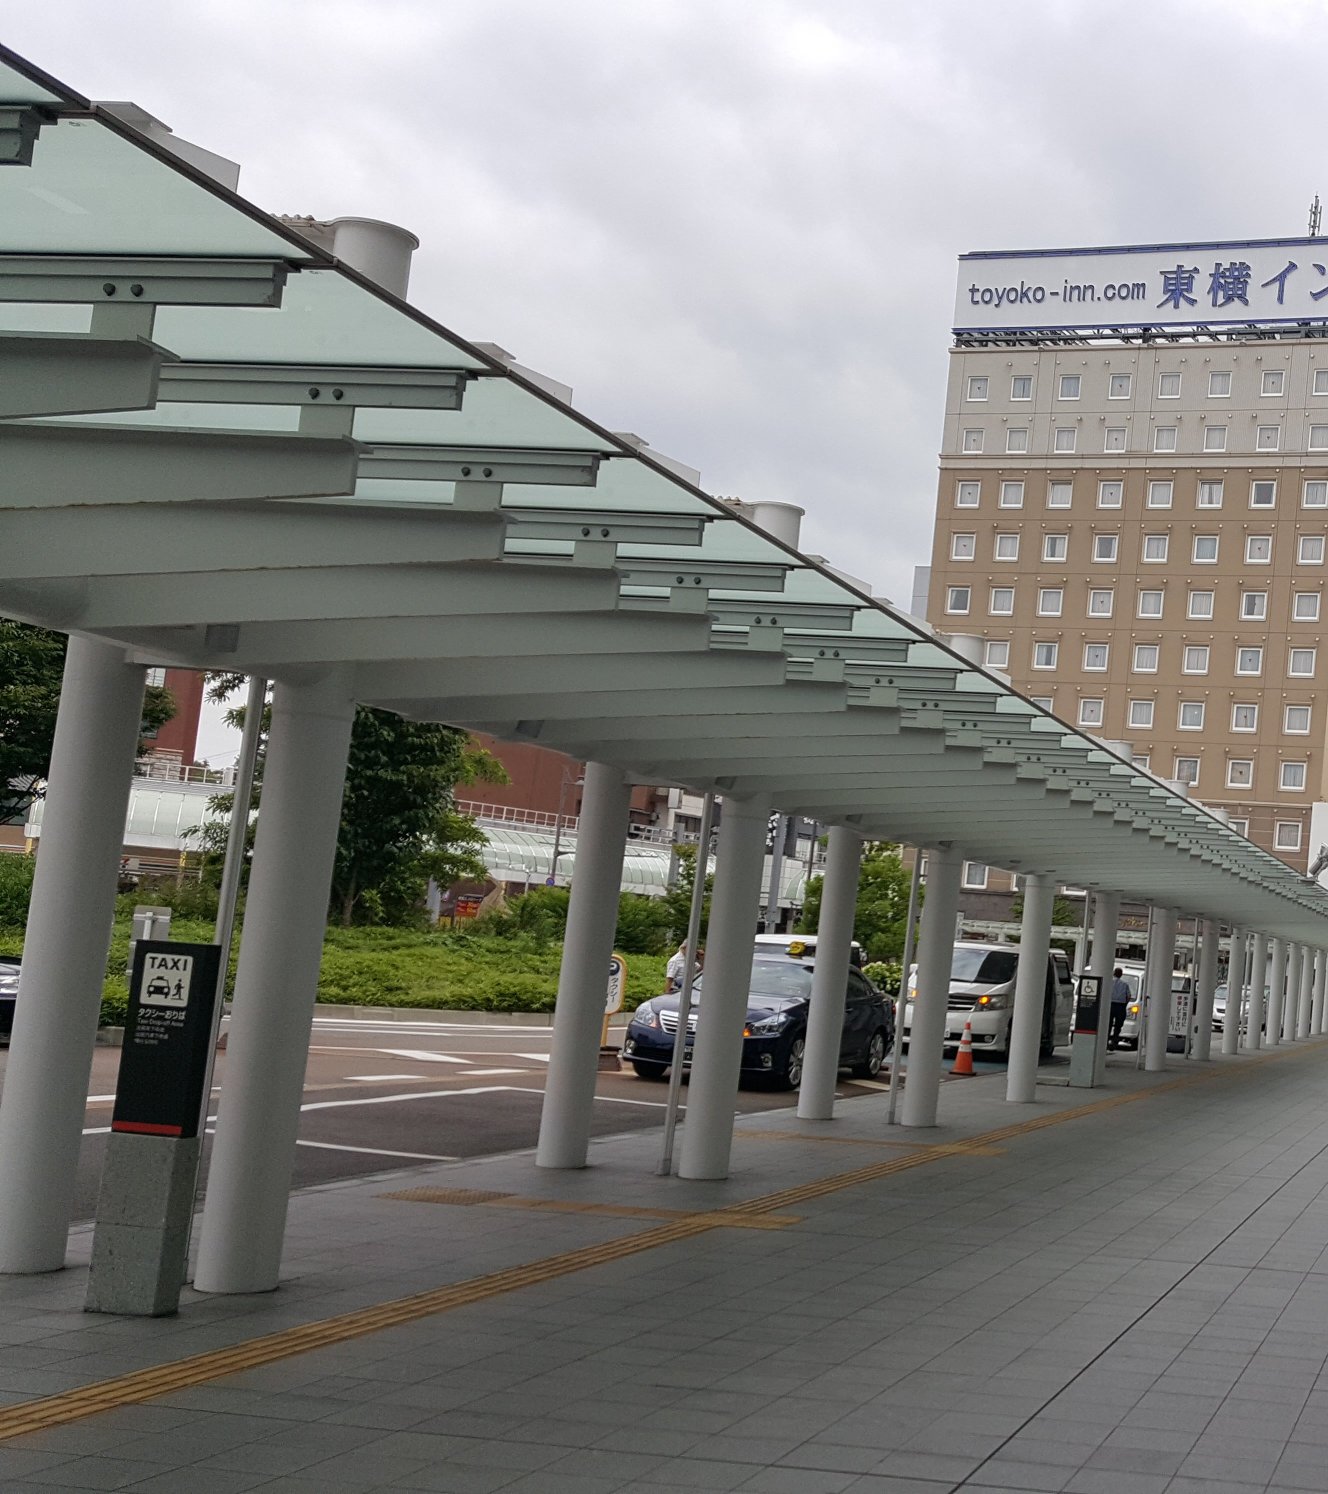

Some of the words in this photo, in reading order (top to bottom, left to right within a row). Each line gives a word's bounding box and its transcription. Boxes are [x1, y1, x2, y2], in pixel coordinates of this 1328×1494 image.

[968, 279, 1146, 308] toyoko-inn.com
[149, 956, 188, 972] TAXI
[610, 977, 619, 1003] タクシー
[137, 1008, 186, 1020] タクシーおりば
